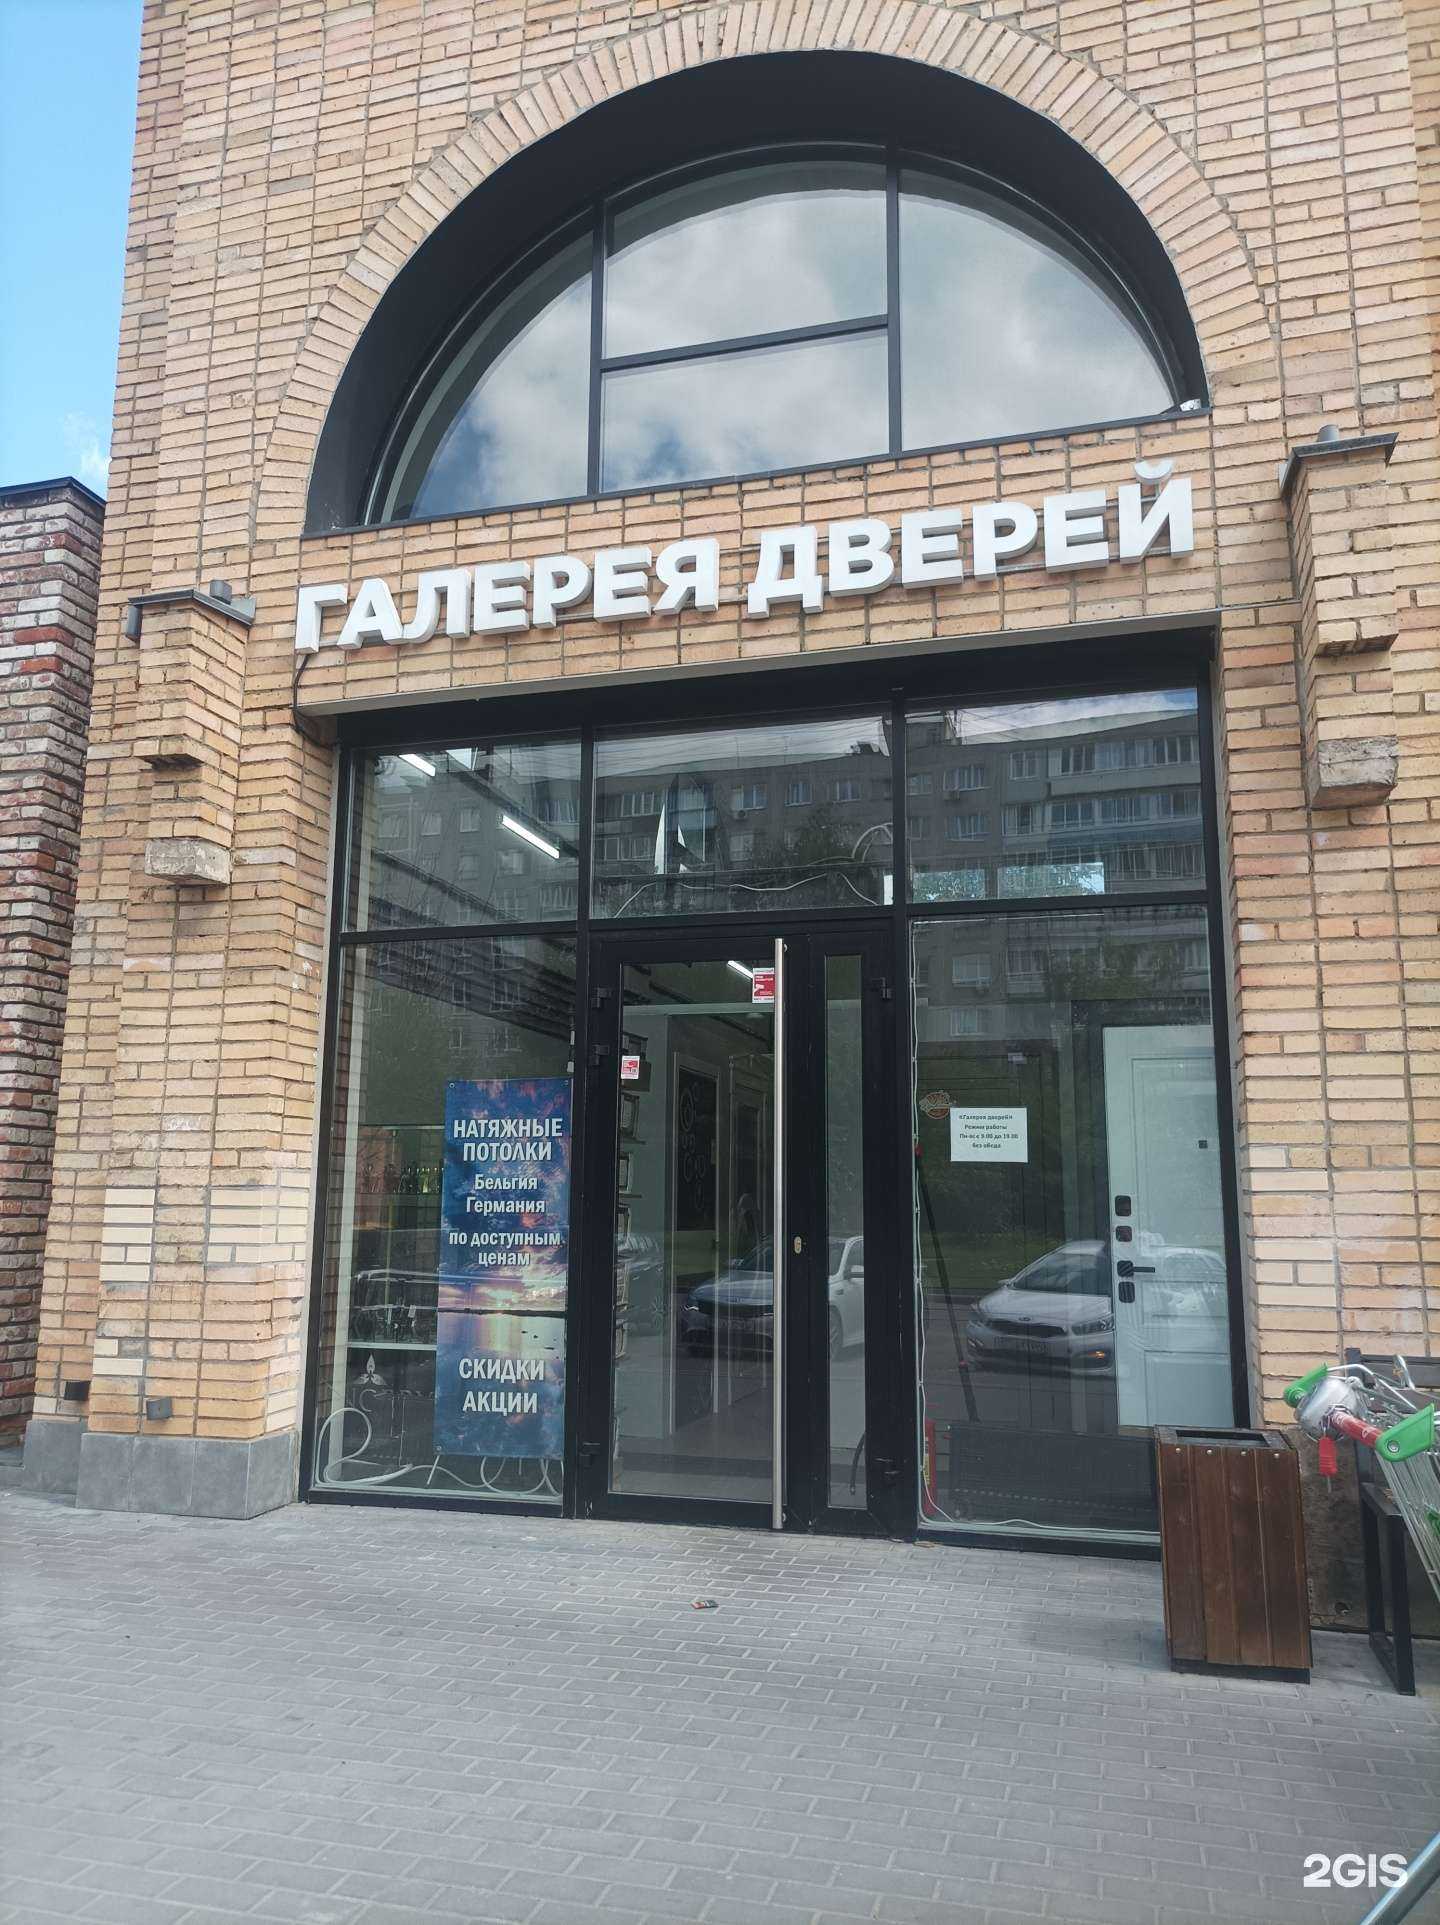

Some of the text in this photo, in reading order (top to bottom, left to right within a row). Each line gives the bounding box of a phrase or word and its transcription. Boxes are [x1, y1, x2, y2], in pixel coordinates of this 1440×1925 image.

[294, 459, 1195, 655] ГАЛЕРЕЯ ДВЕРЕЙ
[453, 1118, 564, 1138] НАТЯЖНЫЕ
[463, 1141, 552, 1162] ПОТОЛКИ
[474, 1174, 538, 1190] Бельгия
[466, 1197, 546, 1216] Германия
[449, 1232, 561, 1249] по доступным
[478, 1251, 530, 1266] ценам
[458, 1358, 545, 1384] СКИДКИ
[462, 1391, 538, 1416] АКЦИИ
